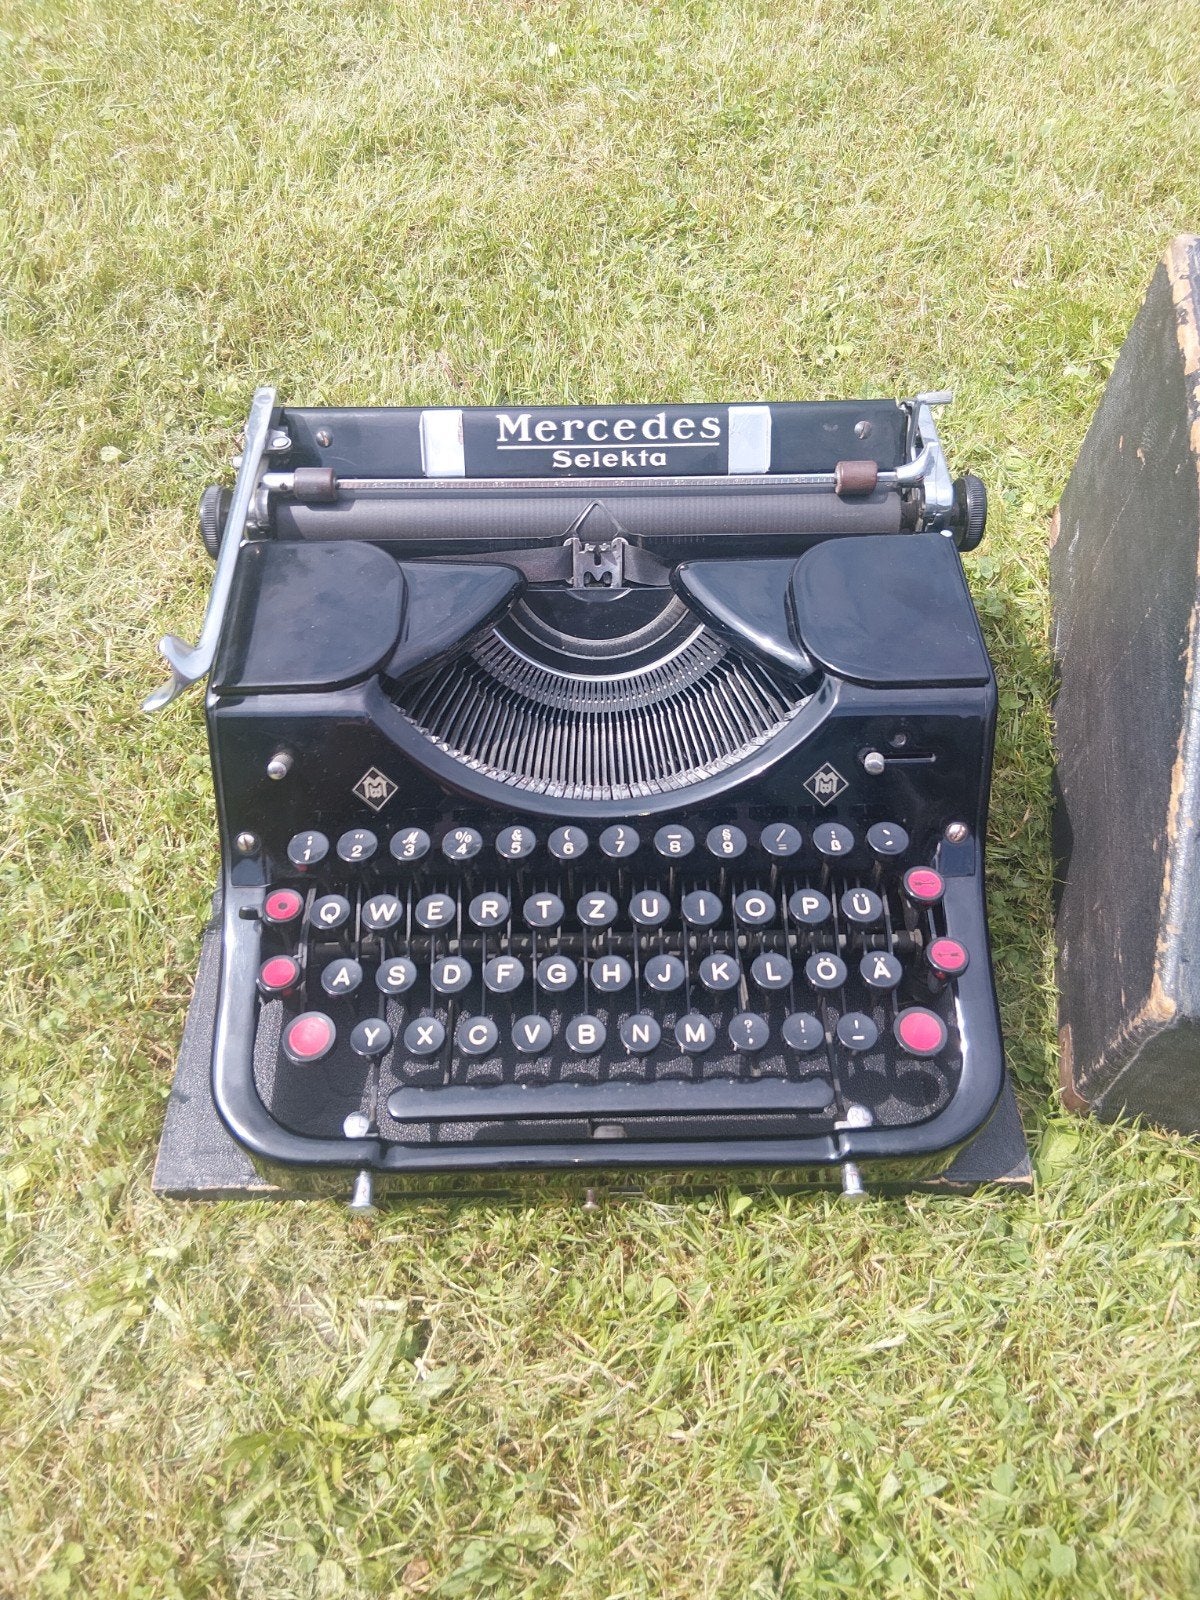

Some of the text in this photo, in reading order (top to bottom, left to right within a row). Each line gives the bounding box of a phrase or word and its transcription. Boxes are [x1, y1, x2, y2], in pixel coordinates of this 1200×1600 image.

[496, 412, 721, 442] Mercedes
[553, 450, 666, 468] Selekta
[512, 829, 522, 841] &
[304, 849, 310, 860] 1
[351, 845, 362, 857] 2
[404, 844, 415, 856] 3
[456, 842, 467, 854] 4
[511, 842, 521, 854] 5
[563, 842, 574, 854] 6
[615, 841, 625, 852] 7
[670, 841, 680, 852] 8
[722, 841, 733, 853] 9
[370, 903, 397, 921] W
[427, 902, 444, 919] E
[481, 901, 498, 918] R
[536, 901, 552, 919] T
[588, 900, 605, 918] Z
[641, 899, 658, 917] U
[699, 899, 705, 916] I
[746, 898, 766, 916] O
[802, 897, 819, 914] P
[852, 893, 870, 915] Ü
[320, 903, 340, 924] Q
[333, 967, 350, 986] A
[387, 966, 405, 985] S
[443, 964, 461, 984] D
[497, 964, 514, 983] F
[547, 964, 567, 983] G
[602, 964, 620, 983] H
[658, 964, 671, 982] J
[712, 961, 729, 981] K
[766, 962, 781, 980] L
[817, 957, 836, 980] Ö
[873, 957, 891, 979] Ä
[364, 1027, 380, 1046] Y
[417, 1026, 433, 1044] X
[469, 1025, 487, 1044] C
[524, 1024, 540, 1043] V
[578, 1024, 595, 1044] B
[632, 1024, 649, 1042] N
[685, 1023, 705, 1042] M
